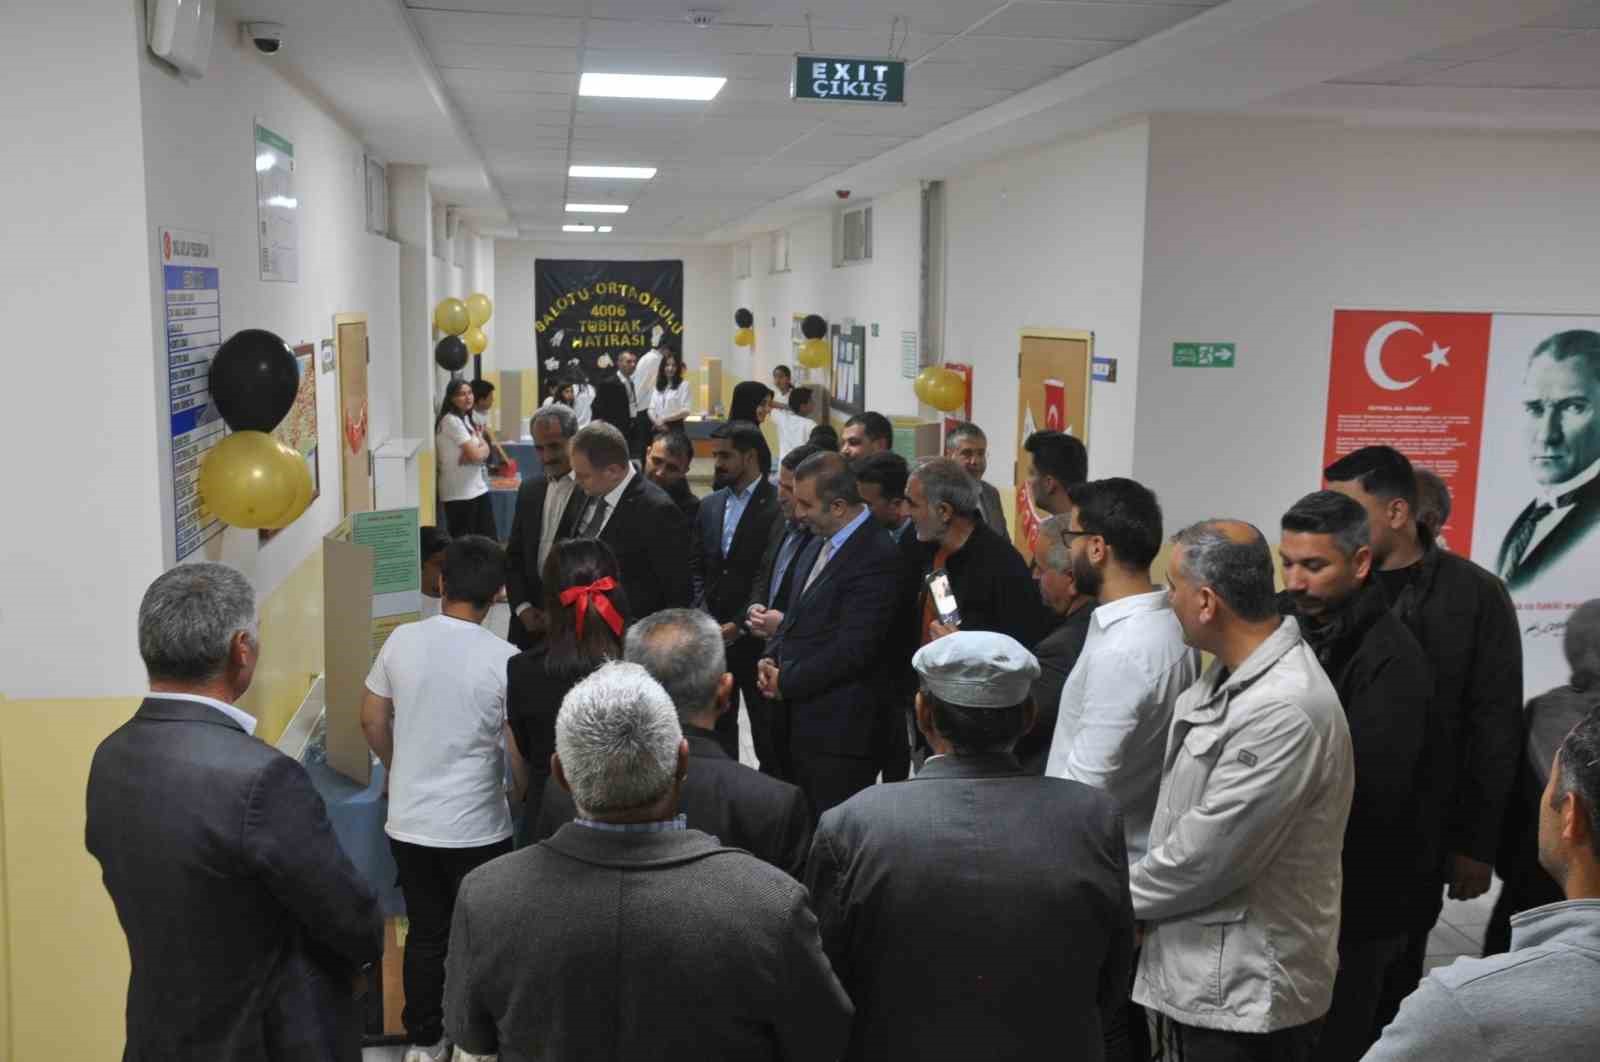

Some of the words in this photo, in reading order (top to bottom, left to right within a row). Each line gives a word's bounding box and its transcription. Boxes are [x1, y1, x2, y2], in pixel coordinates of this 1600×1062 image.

[812, 62, 888, 81] EXIT
[813, 80, 888, 100] ÇIKIŞ
[534, 287, 590, 333] BALOTU
[595, 281, 683, 335] ORTAOKULU
[591, 304, 626, 317] 4006
[572, 334, 646, 348] HATIRASI
